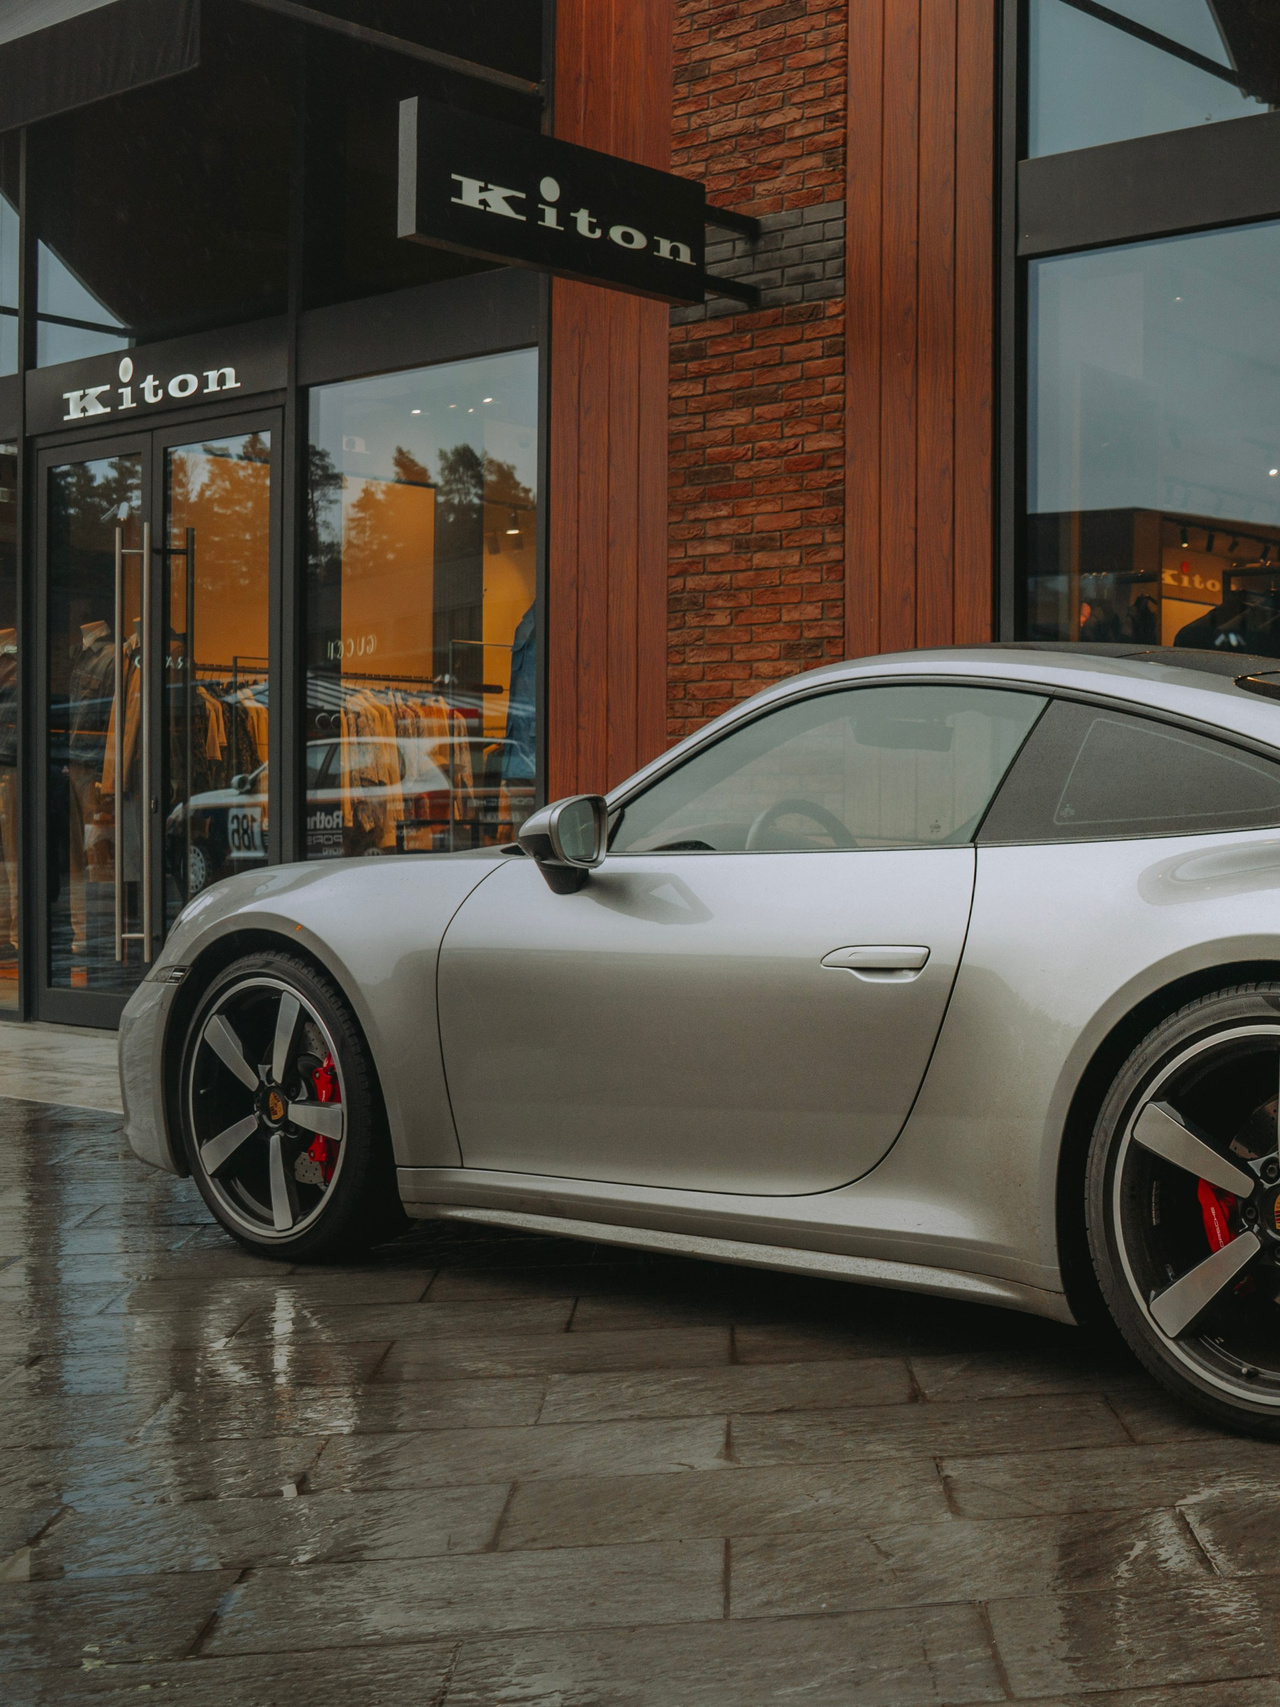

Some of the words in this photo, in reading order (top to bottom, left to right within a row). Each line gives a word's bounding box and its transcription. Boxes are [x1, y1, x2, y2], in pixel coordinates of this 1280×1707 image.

[450, 173, 696, 266] Kiton
[63, 356, 241, 421] Kiton
[1162, 561, 1238, 592] Kito
[1210, 1206, 1225, 1248] ORSCHE
